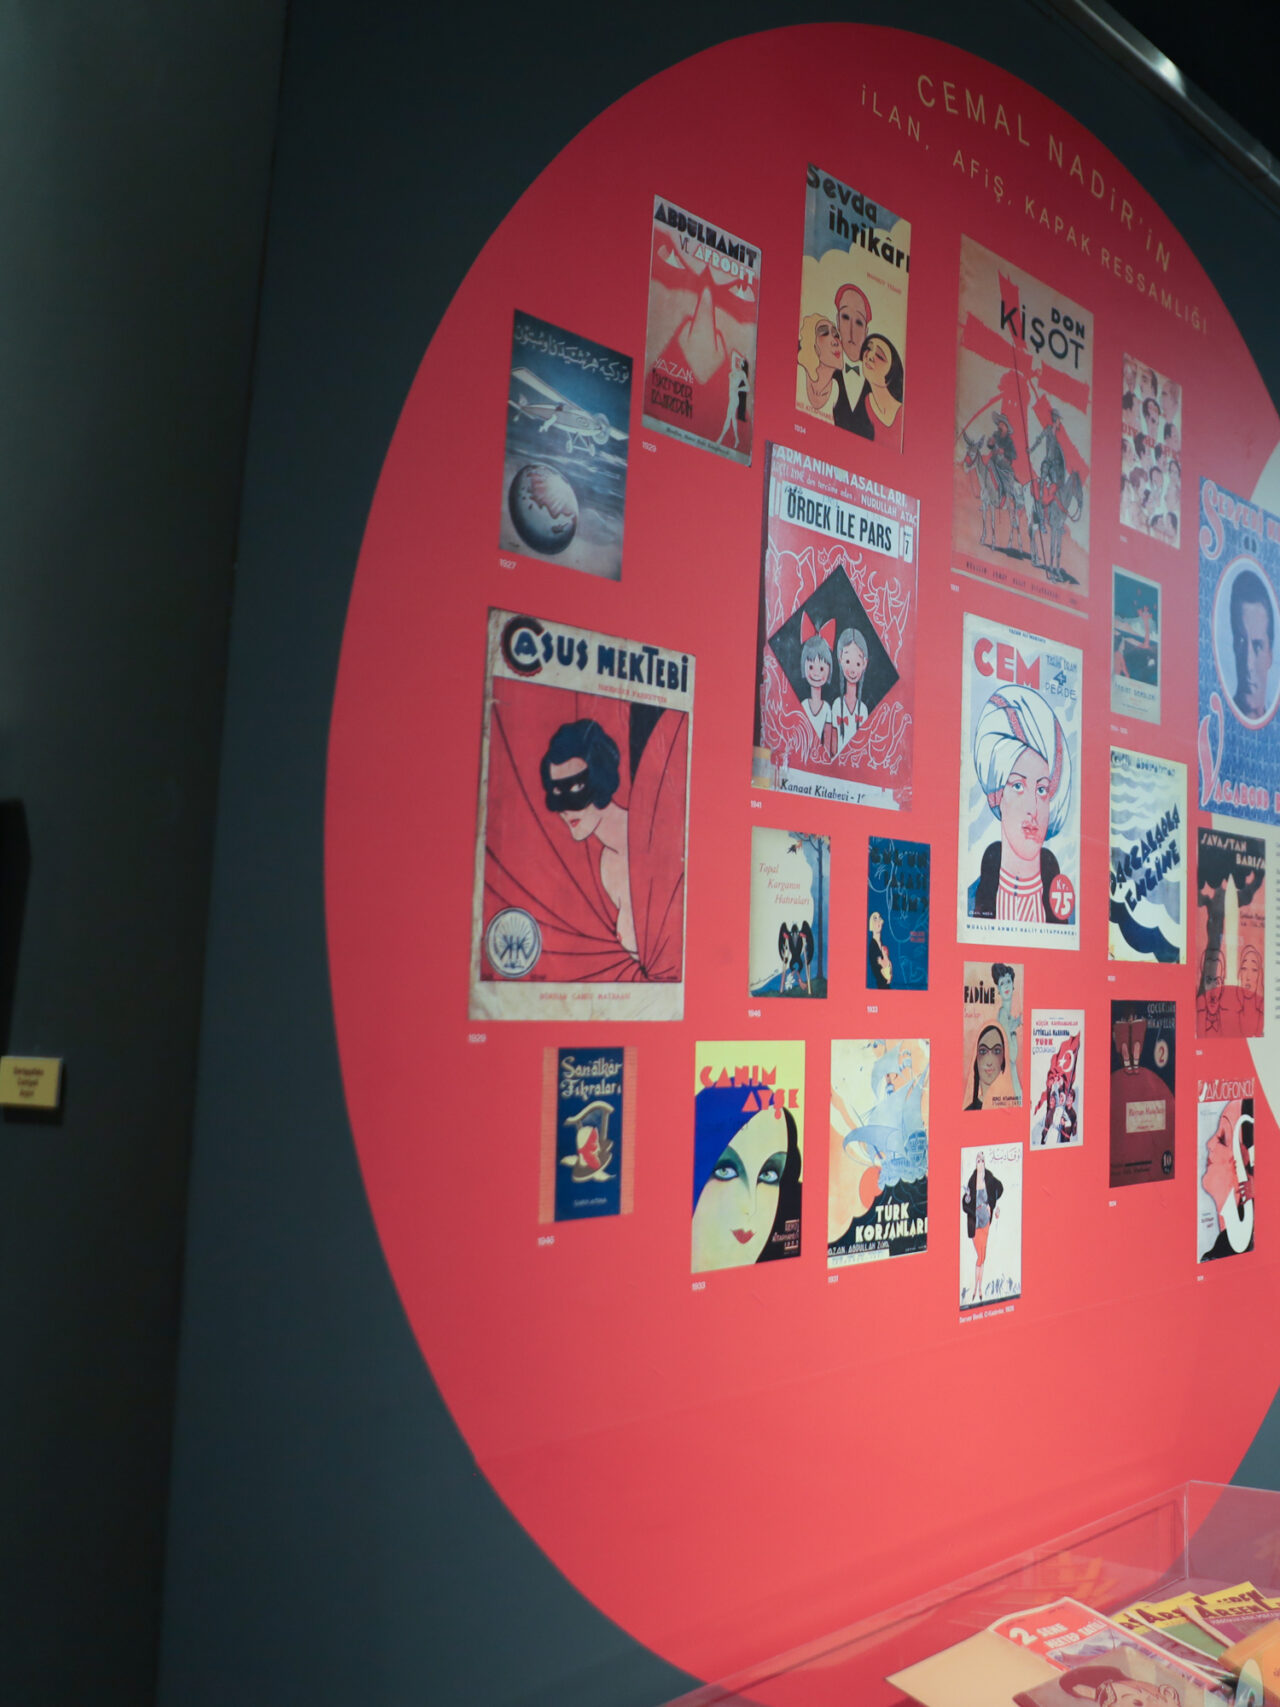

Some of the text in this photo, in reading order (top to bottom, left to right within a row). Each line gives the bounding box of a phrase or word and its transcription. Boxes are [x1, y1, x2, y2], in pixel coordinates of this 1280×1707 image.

[917, 75, 1171, 272] CEMAL NADİR'İN
[806, 165, 878, 224] Sevda
[654, 202, 757, 268] ABDÜLHAMİT
[694, 244, 755, 285] AFRODİT
[1025, 196, 1091, 256] KAPAK
[1101, 247, 1207, 335] RESSAMLIĞI
[1000, 299, 1085, 369] KİŞOT
[1051, 307, 1085, 339] DON
[835, 505, 855, 540] İLE
[859, 517, 892, 552] PARS
[502, 614, 690, 693] CASUS MEKTEBİ
[974, 637, 1041, 690] CEM
[1045, 681, 1078, 701] PERDE
[1053, 670, 1068, 687] 4
[780, 778, 812, 795] Kanaat
[814, 785, 850, 802] Kitabevi
[759, 862, 780, 877] Topal
[1051, 891, 1073, 916] 75
[964, 980, 995, 1004] FADİME
[1157, 1046, 1166, 1064] 2
[700, 1065, 777, 1089] CANIM
[741, 1088, 799, 1120] AYŞE
[855, 1217, 928, 1243] KORSANLARI
[1194, 1603, 1258, 1620] ARSEN
[1009, 1627, 1038, 1646] 2
